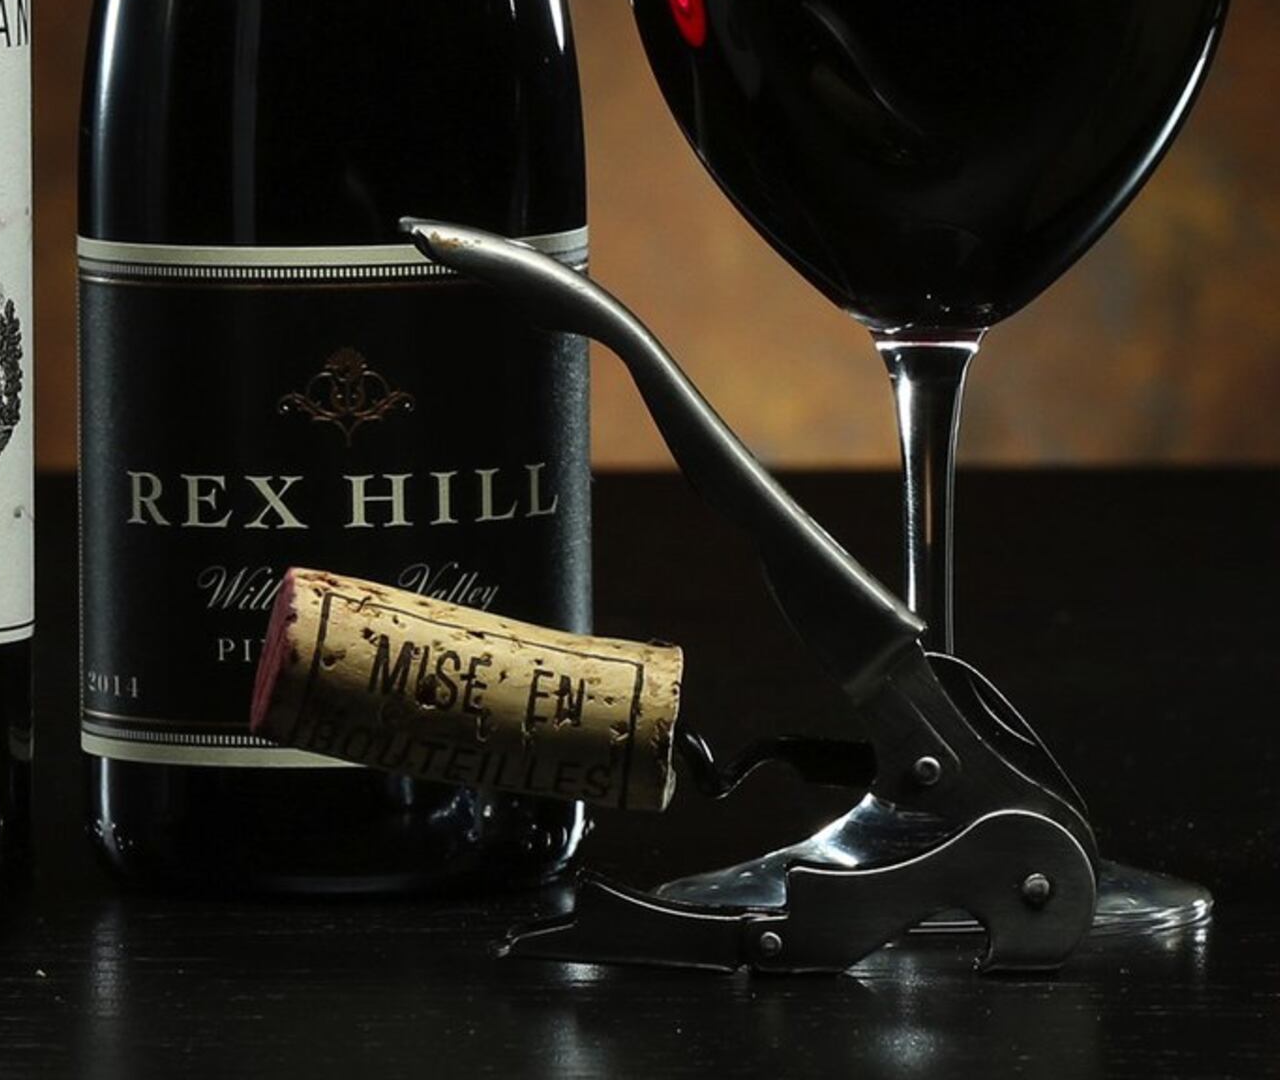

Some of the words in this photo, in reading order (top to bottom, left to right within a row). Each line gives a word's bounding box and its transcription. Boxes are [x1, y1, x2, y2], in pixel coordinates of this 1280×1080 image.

[126, 470, 309, 530] REX
[343, 461, 559, 529] HILL
[87, 671, 141, 698] 2014
[370, 634, 492, 714] MISE
[527, 669, 586, 728] EN
